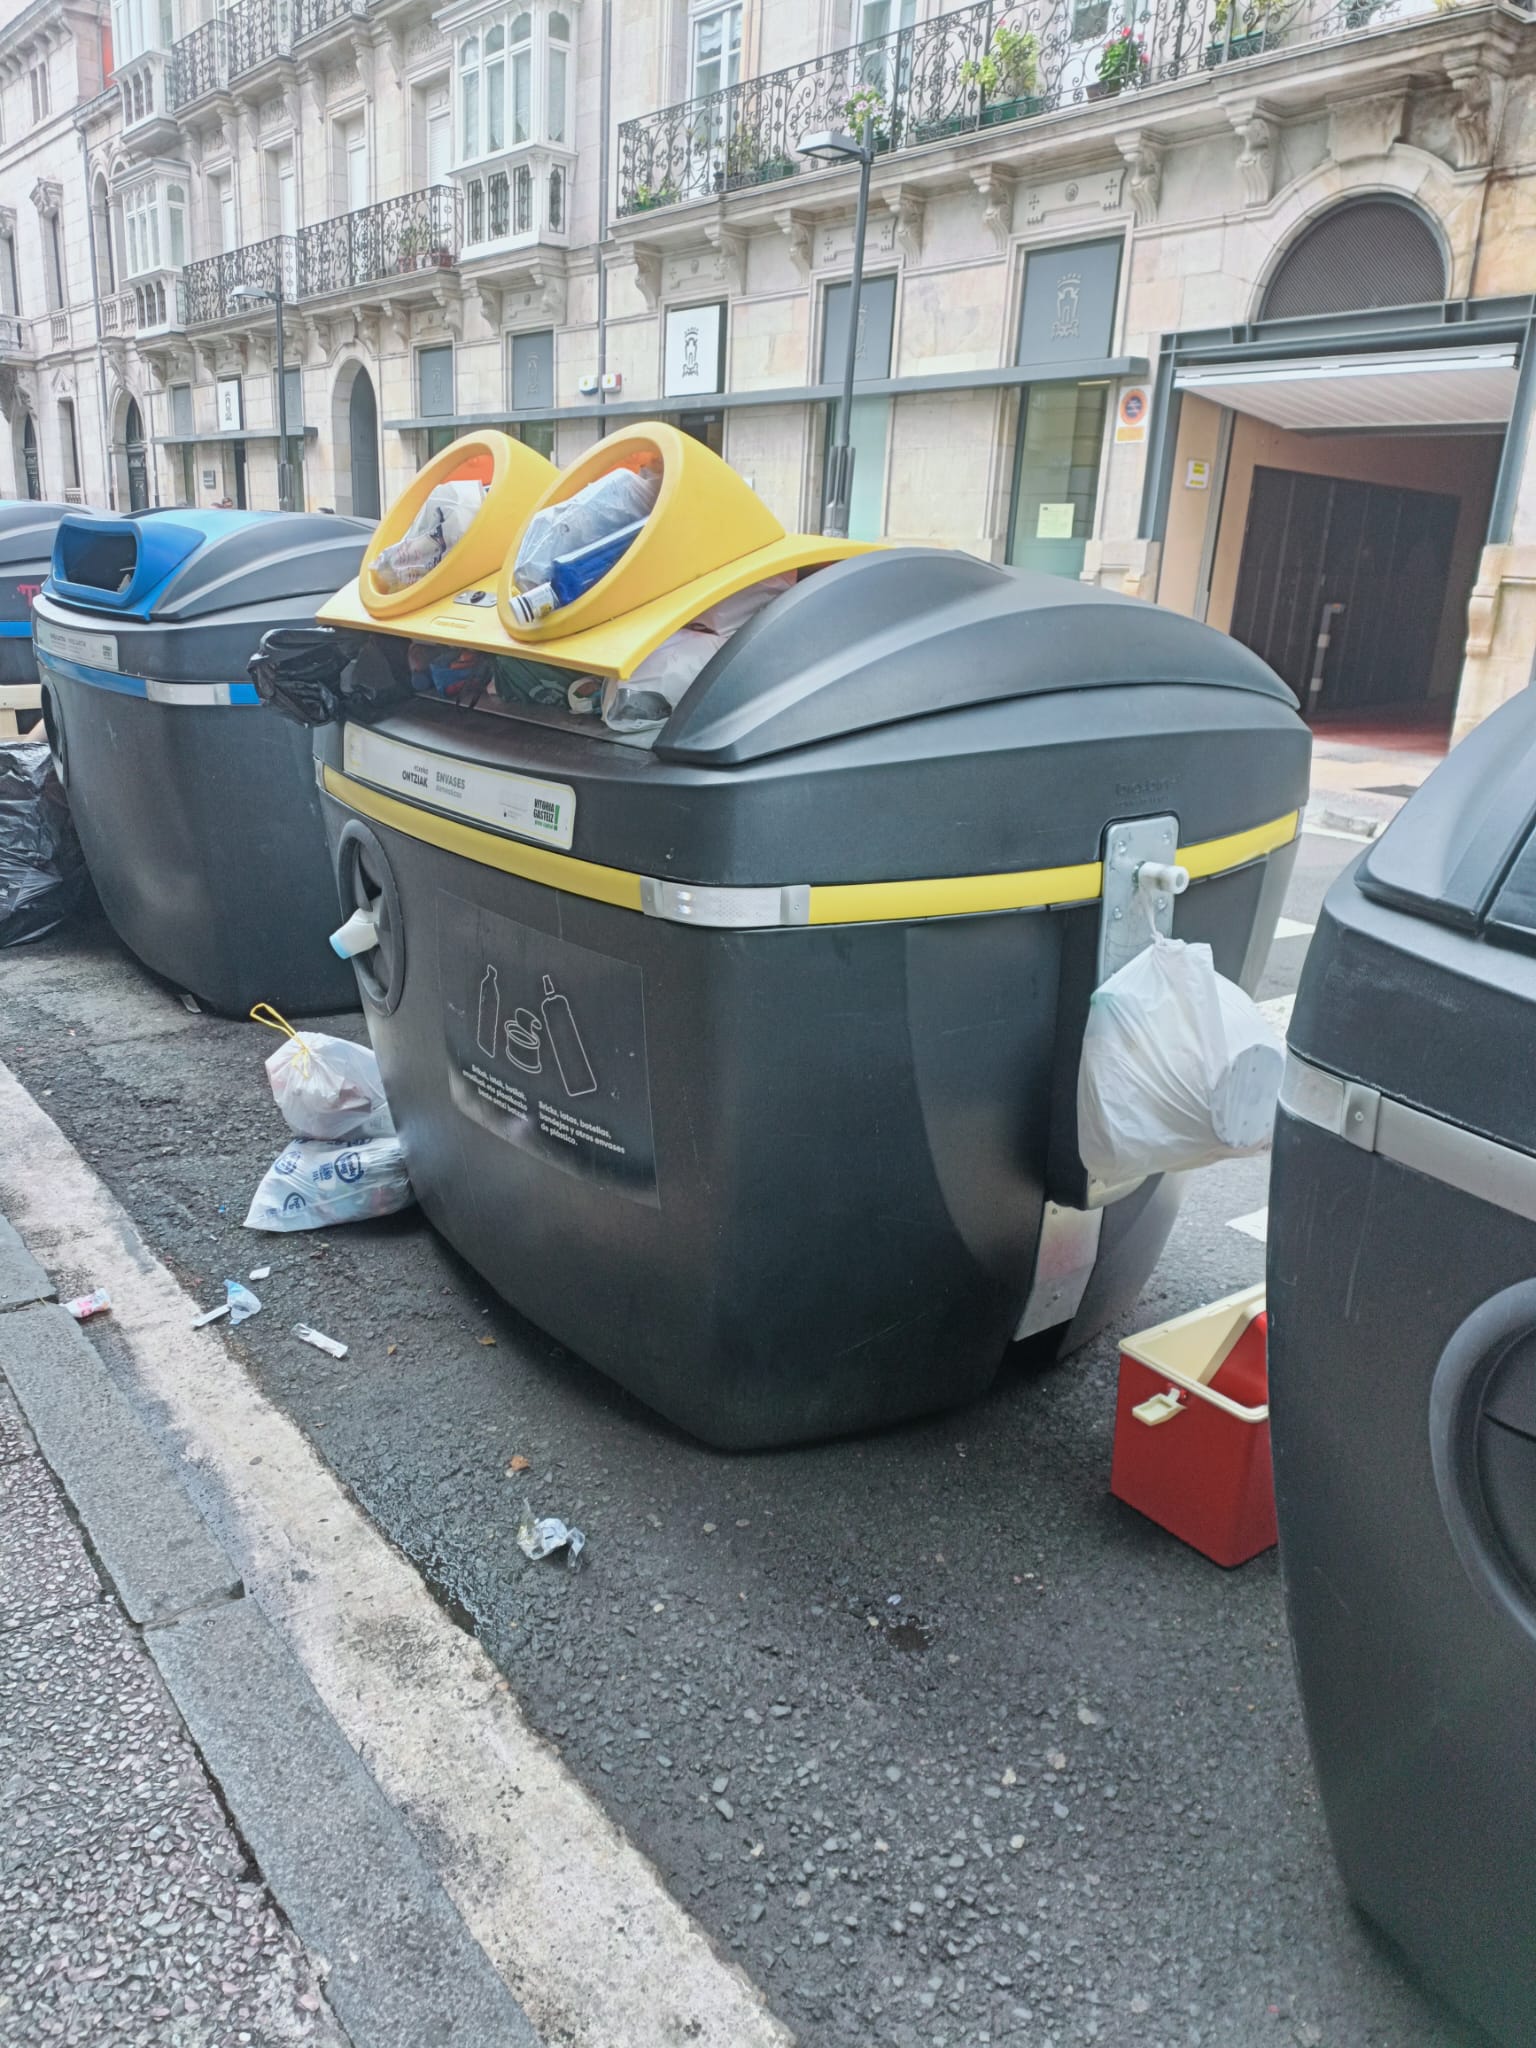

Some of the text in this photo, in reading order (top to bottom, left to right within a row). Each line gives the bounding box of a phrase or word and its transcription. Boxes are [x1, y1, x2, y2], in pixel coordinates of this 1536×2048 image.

[402, 770, 428, 788] ONTZIAK
[436, 771, 465, 790] ENVASES
[534, 798, 554, 812] VITORIA
[533, 809, 554, 823] GASTEIZ
[595, 1138, 625, 1154] envases
